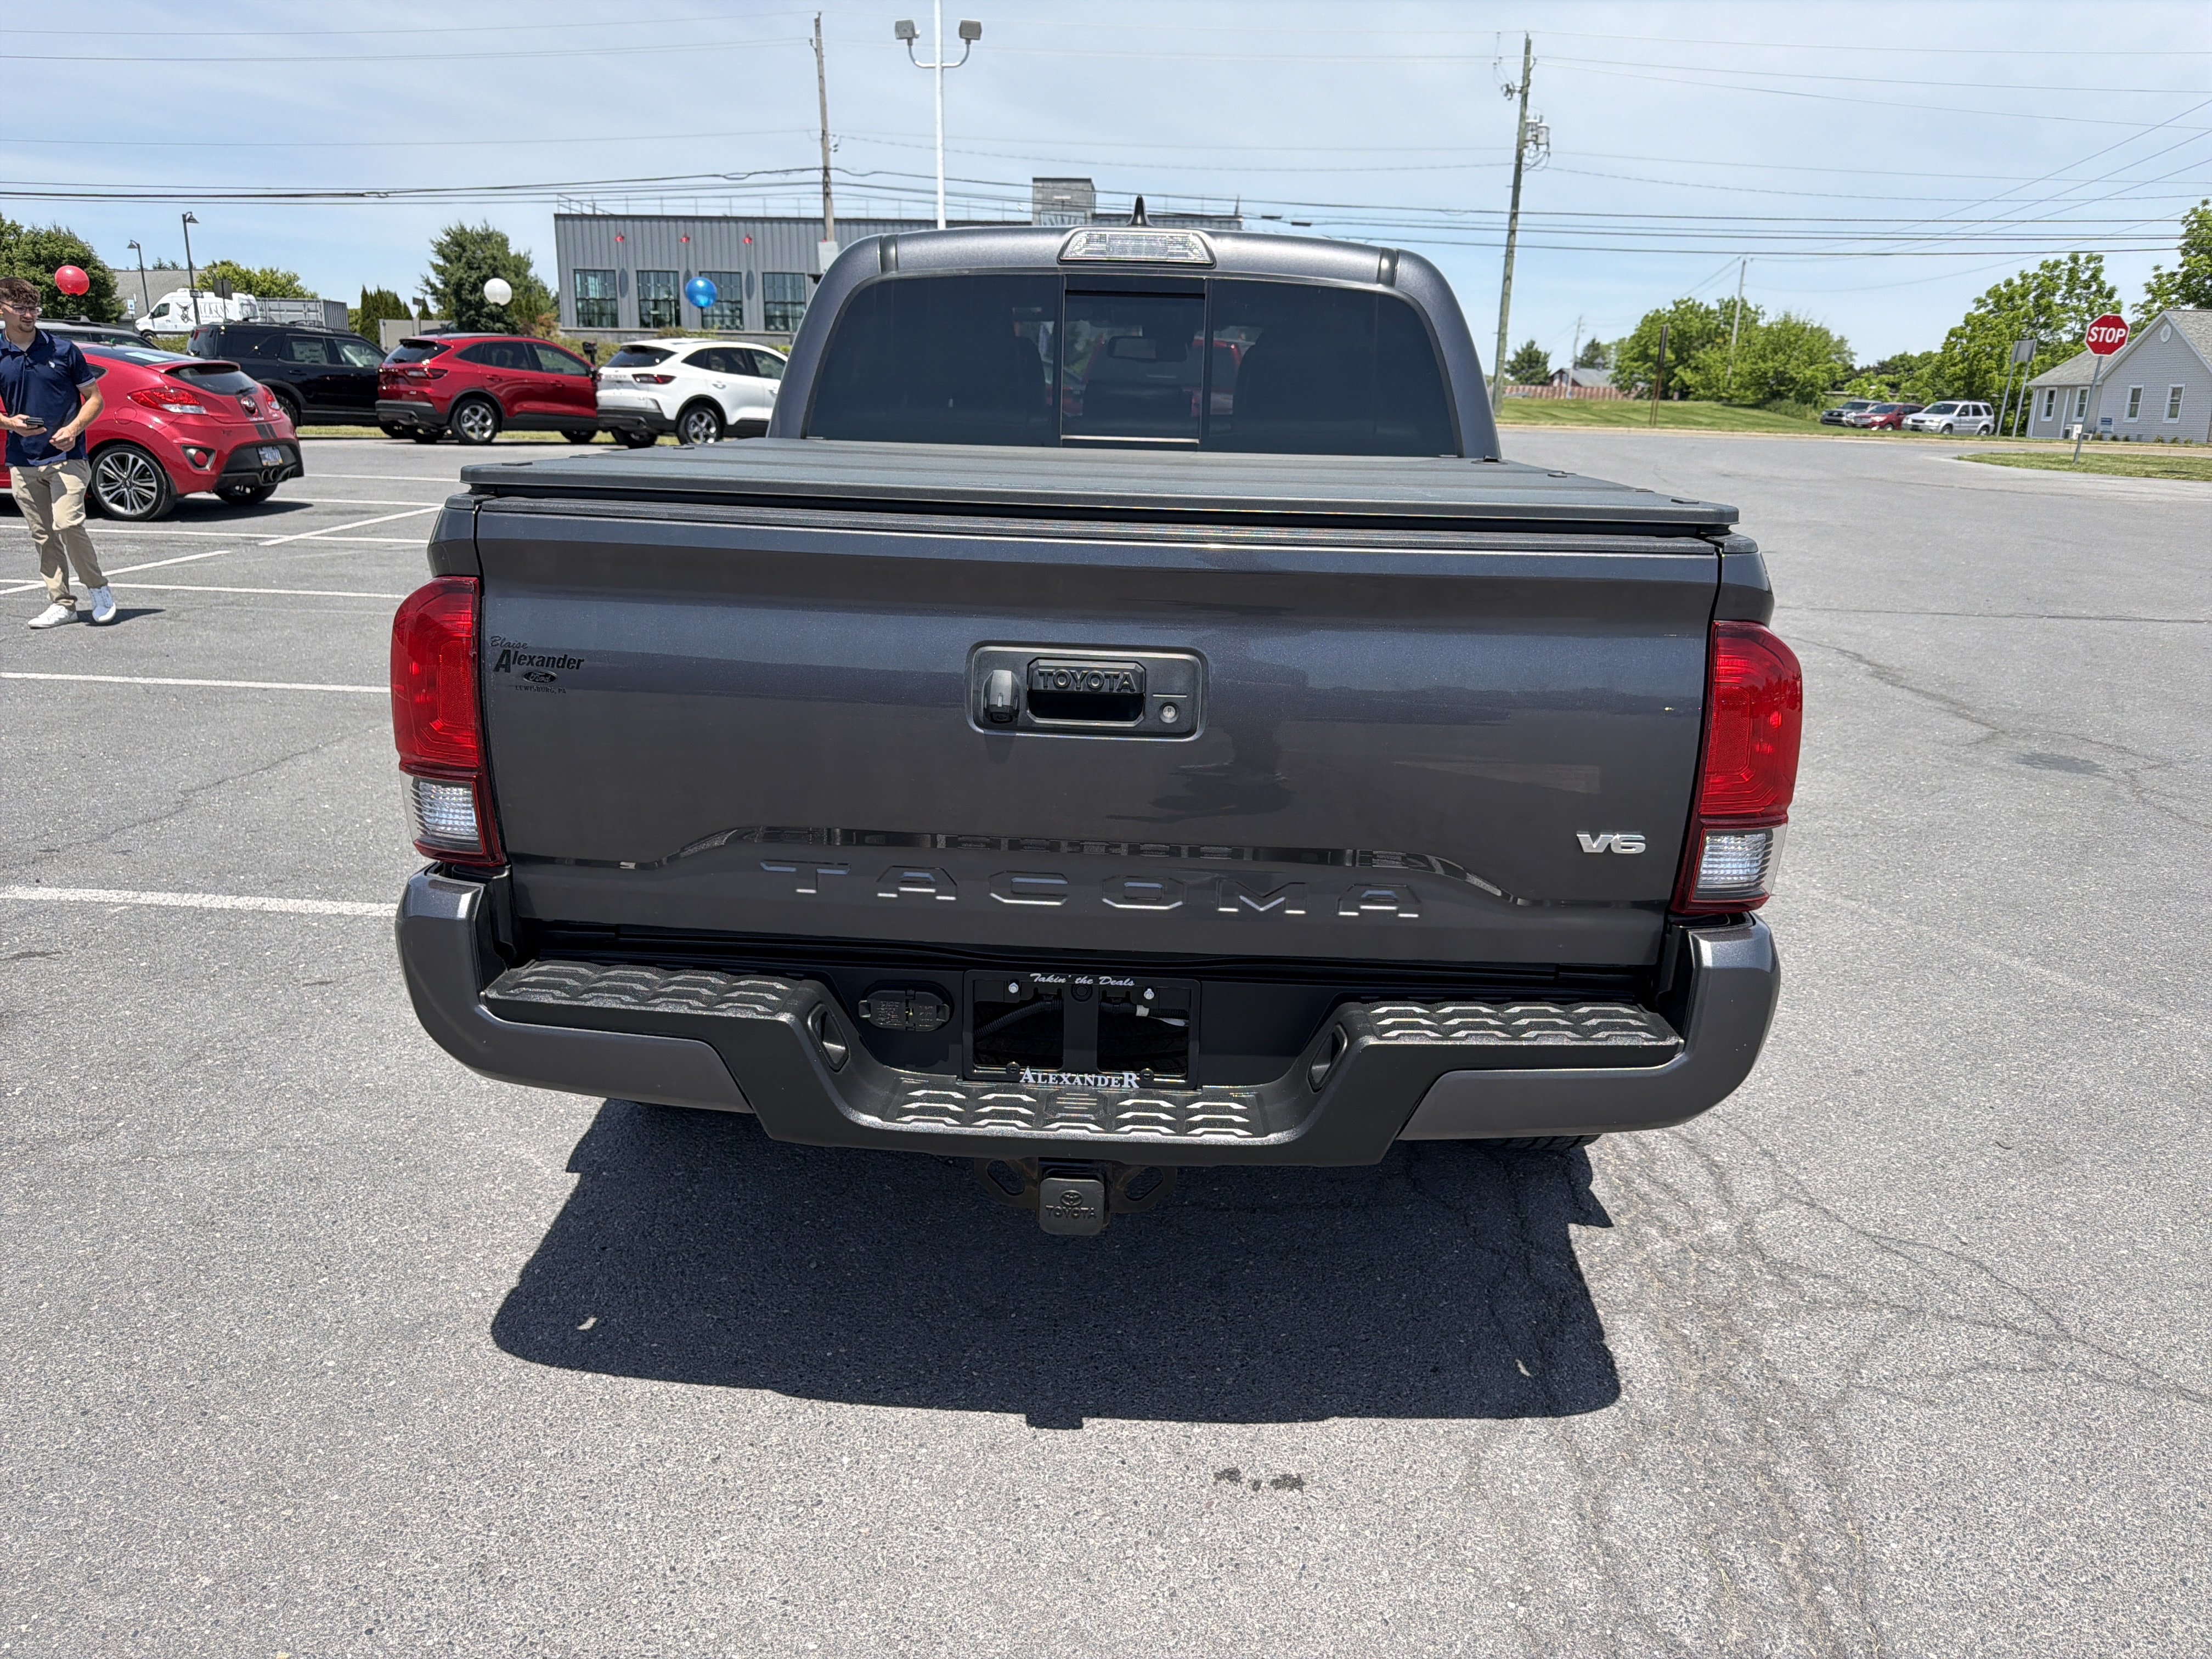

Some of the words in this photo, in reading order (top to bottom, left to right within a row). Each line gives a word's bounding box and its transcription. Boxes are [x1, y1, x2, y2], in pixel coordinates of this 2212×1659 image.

[2088, 326, 2126, 343] STOP
[490, 635, 528, 649] Blaise
[494, 650, 585, 673] Alexander
[1038, 668, 1136, 693] TOYOTA
[1576, 833, 1645, 854] V6
[760, 860, 1422, 917] TACOMA
[1030, 973, 1071, 984] Takin'
[1075, 975, 1093, 984] the
[1098, 975, 1135, 986] Deals
[1019, 1066, 1139, 1088] ALEXANDER
[1046, 1205, 1097, 1219] TOYOTA
